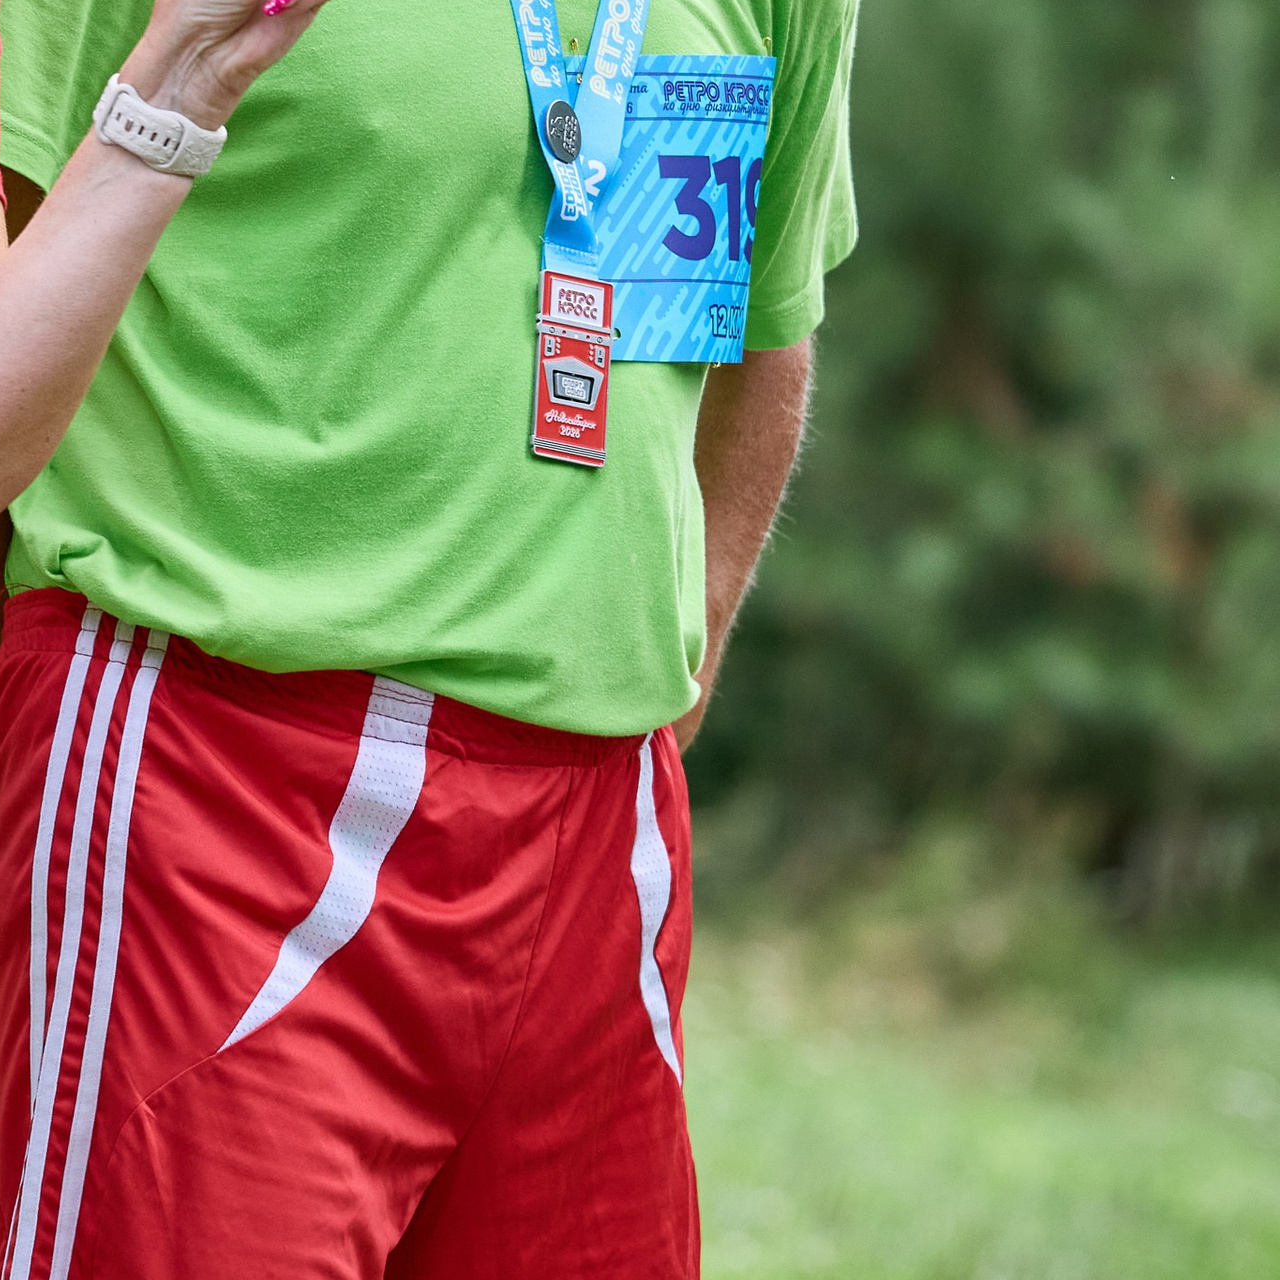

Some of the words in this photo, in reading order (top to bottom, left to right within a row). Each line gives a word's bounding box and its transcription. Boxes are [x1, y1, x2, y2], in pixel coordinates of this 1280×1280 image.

[542, 17, 560, 57] дню
[550, 65, 562, 88] ко
[613, 81, 625, 105] ко
[621, 40, 636, 78] дню
[663, 81, 720, 103] РЕТРО
[663, 99, 675, 111] ко
[679, 102, 700, 115] дню
[558, 288, 595, 306] РЕТРО
[558, 300, 598, 320] КРОСС
[709, 304, 727, 339] 12
